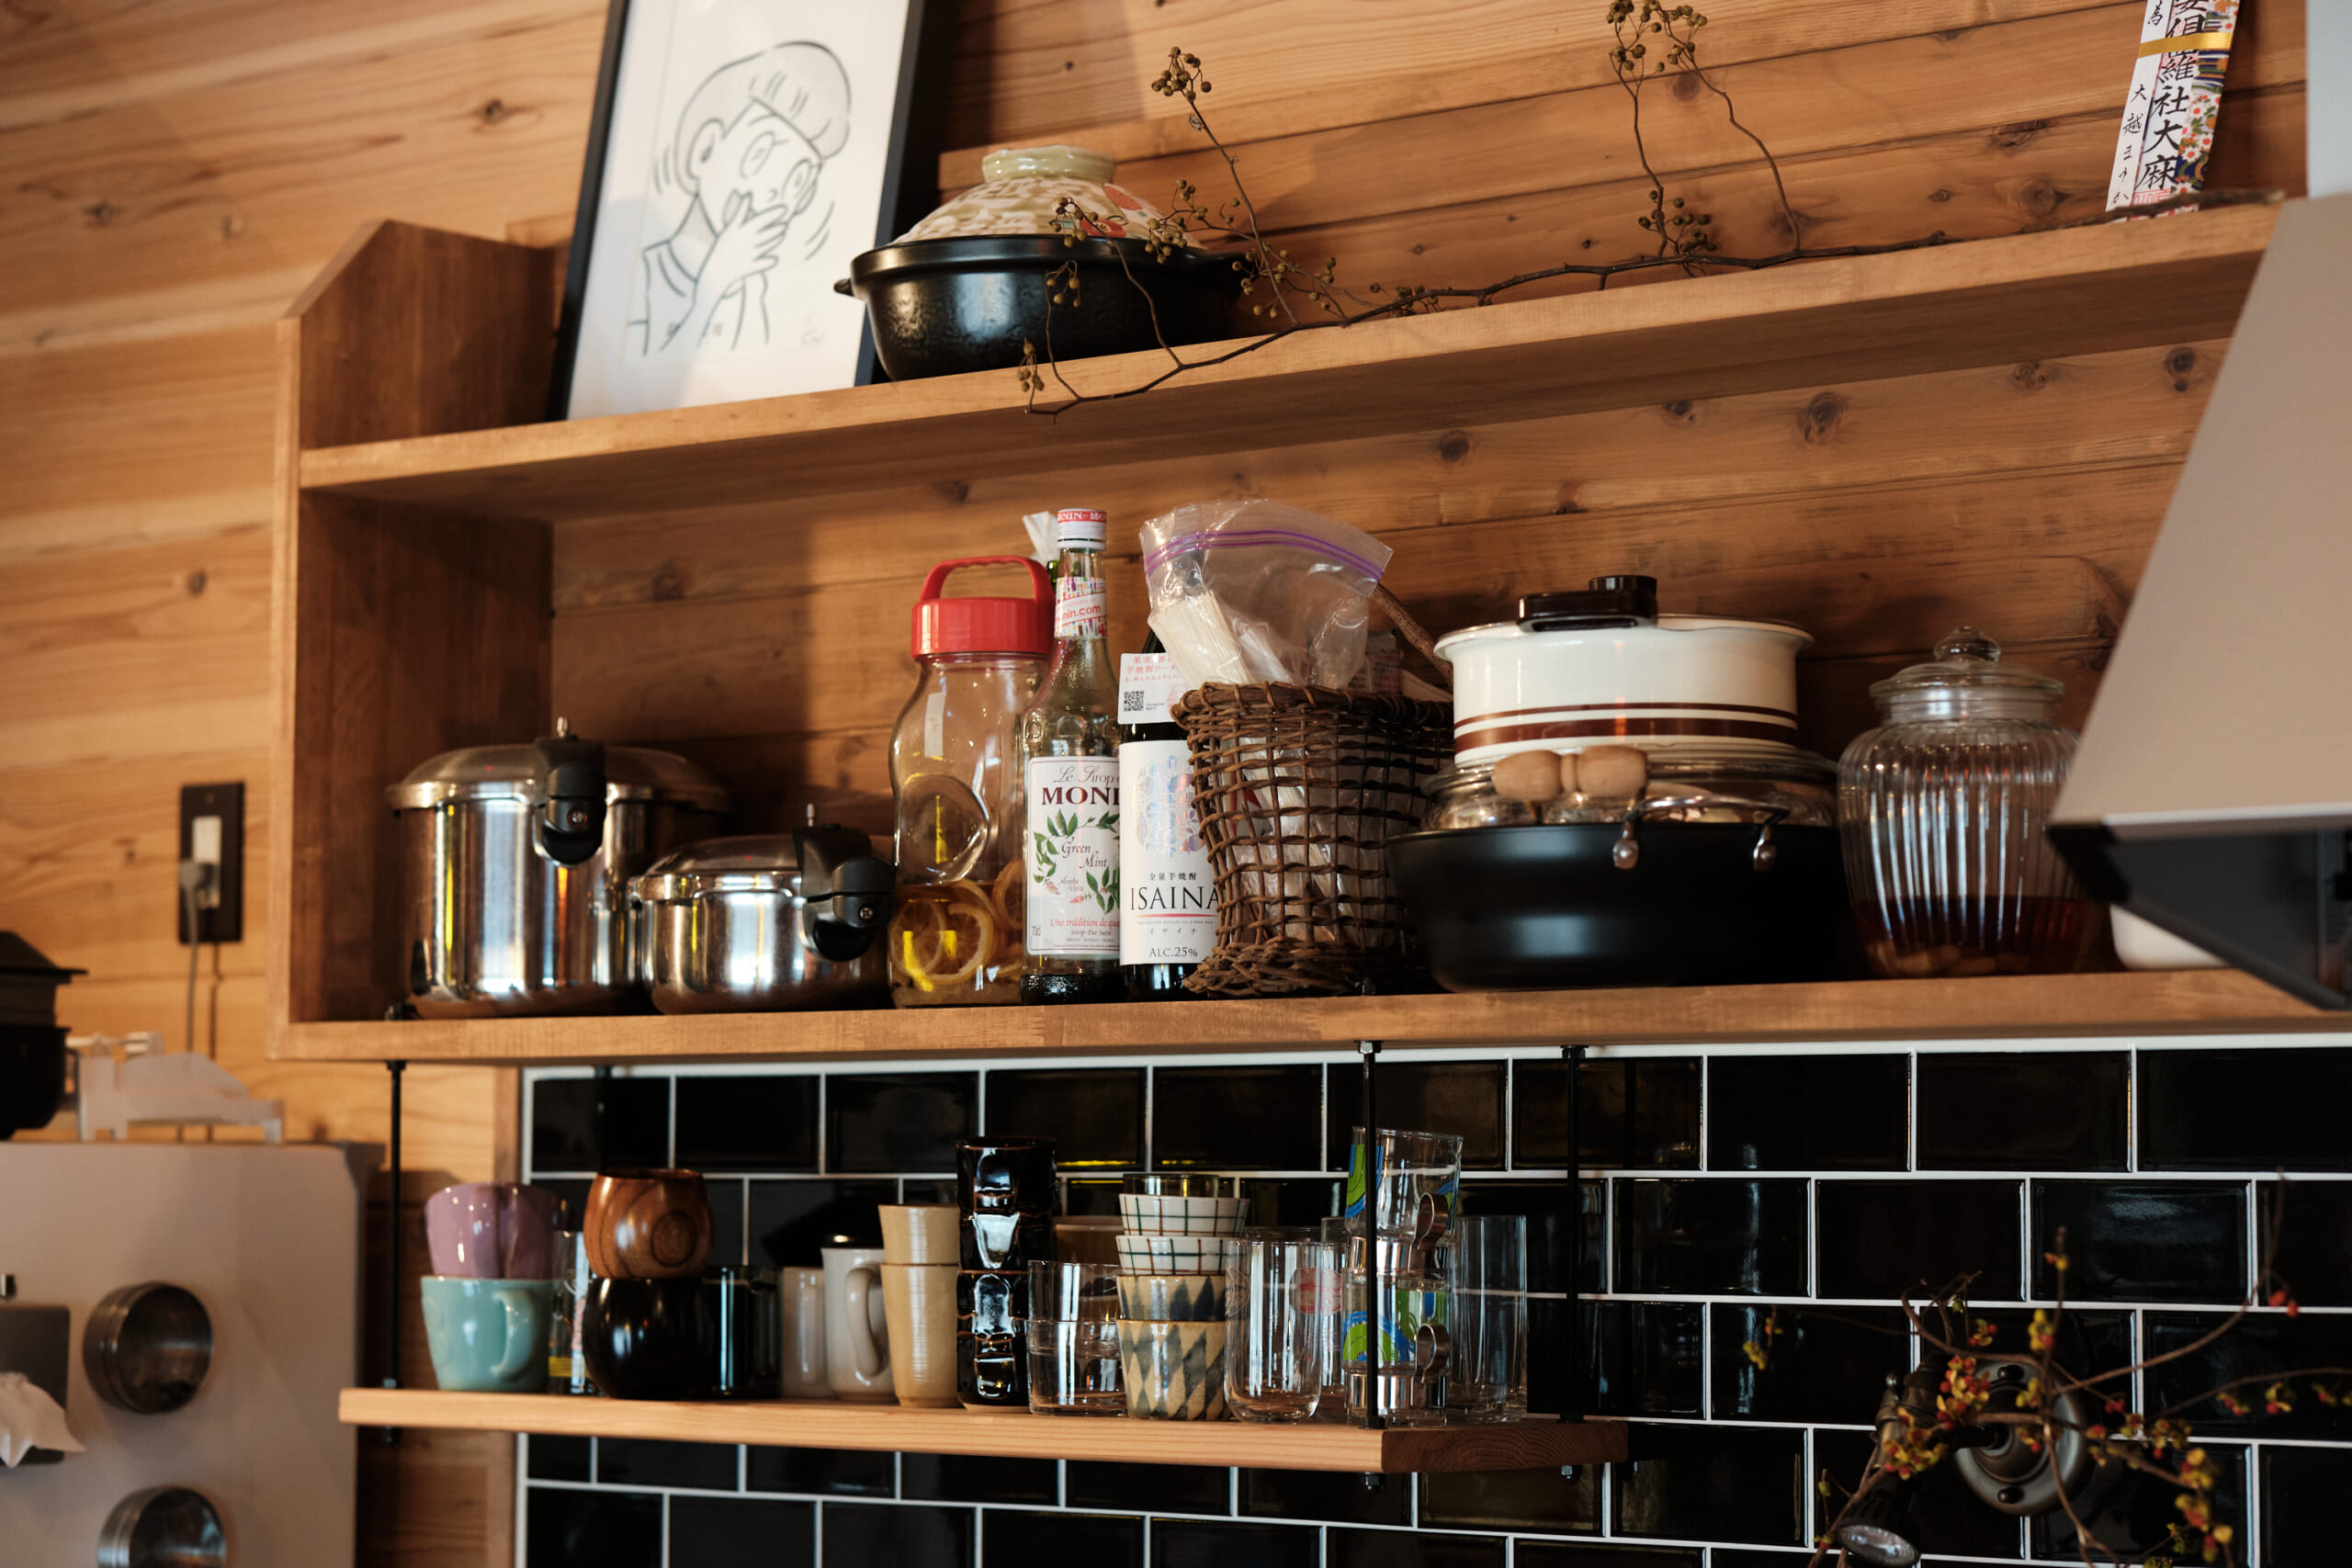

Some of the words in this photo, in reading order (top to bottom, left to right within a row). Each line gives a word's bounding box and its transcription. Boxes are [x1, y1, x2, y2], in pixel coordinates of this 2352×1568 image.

[1052, 765, 1075, 784] Le
[1078, 765, 1115, 787] Sirop
[1061, 836, 1091, 859] Green
[1079, 851, 1108, 869] Mint
[1149, 872, 1197, 881] 全量芋焼酎
[1130, 886, 1219, 910] ISAINA
[1050, 919, 1065, 927] Une
[1066, 917, 1098, 927] tradition
[1148, 946, 1198, 957] ALC.25%
